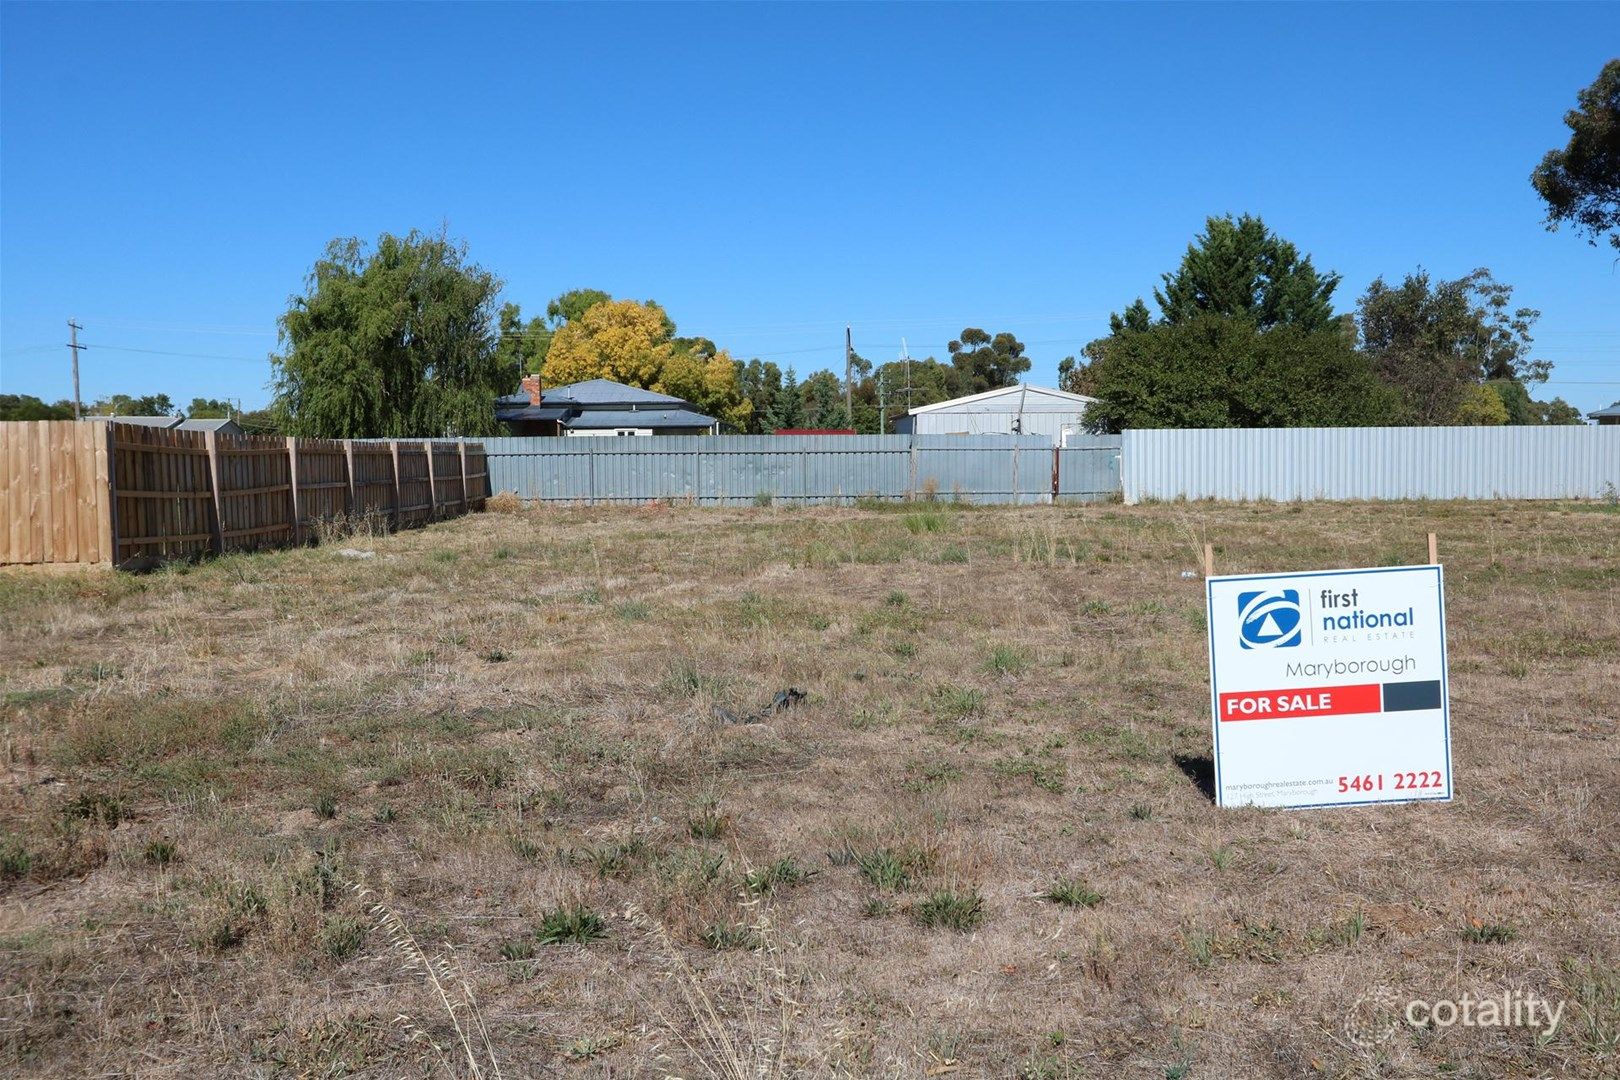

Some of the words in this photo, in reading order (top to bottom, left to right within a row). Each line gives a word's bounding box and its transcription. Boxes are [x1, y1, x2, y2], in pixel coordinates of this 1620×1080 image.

[1321, 589, 1358, 608] first
[1323, 607, 1413, 630] national
[1324, 635, 1356, 643] REAL
[1367, 631, 1414, 641] ESTATE
[1286, 655, 1416, 678] Maryborough
[1227, 697, 1272, 715] FOR
[1277, 693, 1332, 712] SALE
[1226, 778, 1334, 791] maryboroughrealestate.com.au
[1338, 775, 1384, 793] 5461
[1394, 771, 1443, 790] 2222
